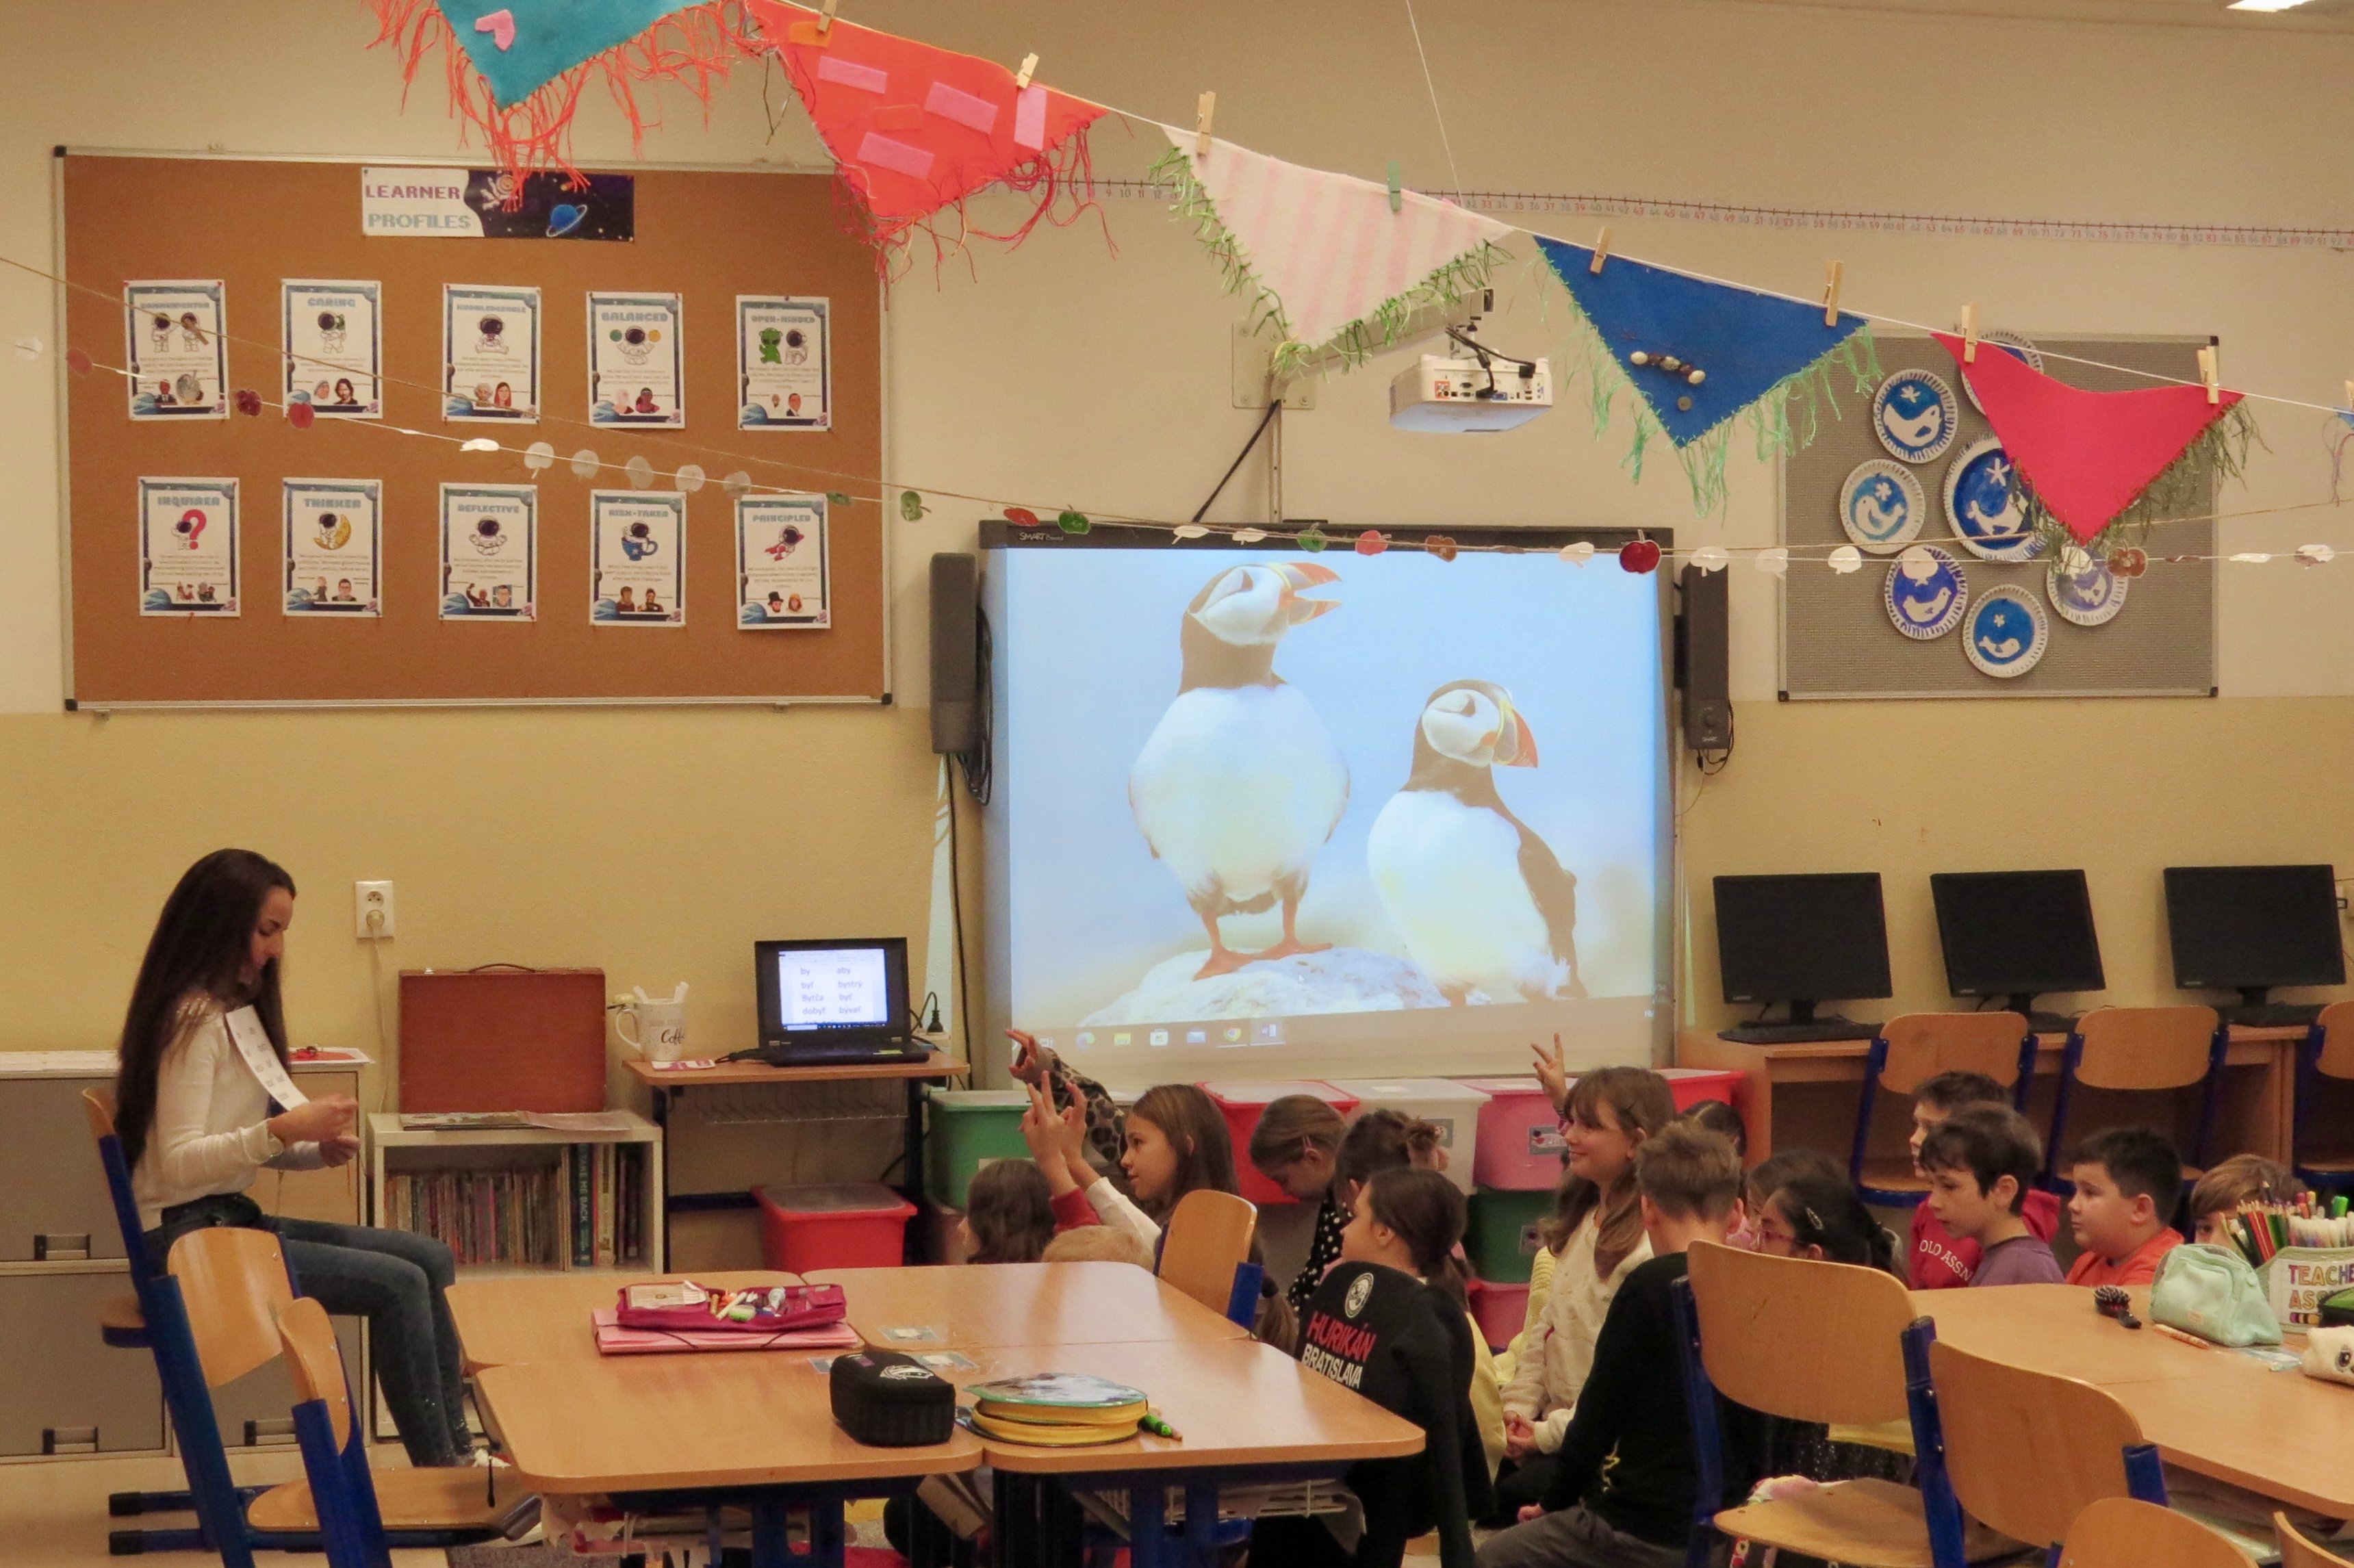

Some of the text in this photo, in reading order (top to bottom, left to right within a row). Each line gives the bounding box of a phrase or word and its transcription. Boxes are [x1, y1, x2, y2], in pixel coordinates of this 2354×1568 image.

[365, 185, 460, 199] LEARNER
[1544, 203, 1555, 211] 37
[1575, 203, 1585, 211] 39
[1694, 211, 1706, 220] 47
[1724, 214, 1735, 222] 49
[1754, 216, 1764, 224] 51
[368, 214, 471, 229] PROFILES
[307, 297, 356, 307] CARING
[601, 312, 669, 322] BALANCED
[304, 498, 361, 509] THINKER
[457, 503, 520, 513] REFLECTIVE
[1019, 532, 1047, 541] SMART
[799, 967, 810, 976] by
[836, 966, 852, 975] aby
[802, 993, 824, 1003] Bytča
[579, 1181, 588, 1194] ME
[580, 1196, 588, 1222] BACK
[1919, 1239, 1943, 1256] OLD
[2288, 1263, 2354, 1286] TEACHE
[2288, 1289, 2329, 1310] ASS
[1307, 1311, 1377, 1363] HURIKÁN
[1302, 1343, 1364, 1389] BRATISLAVA
